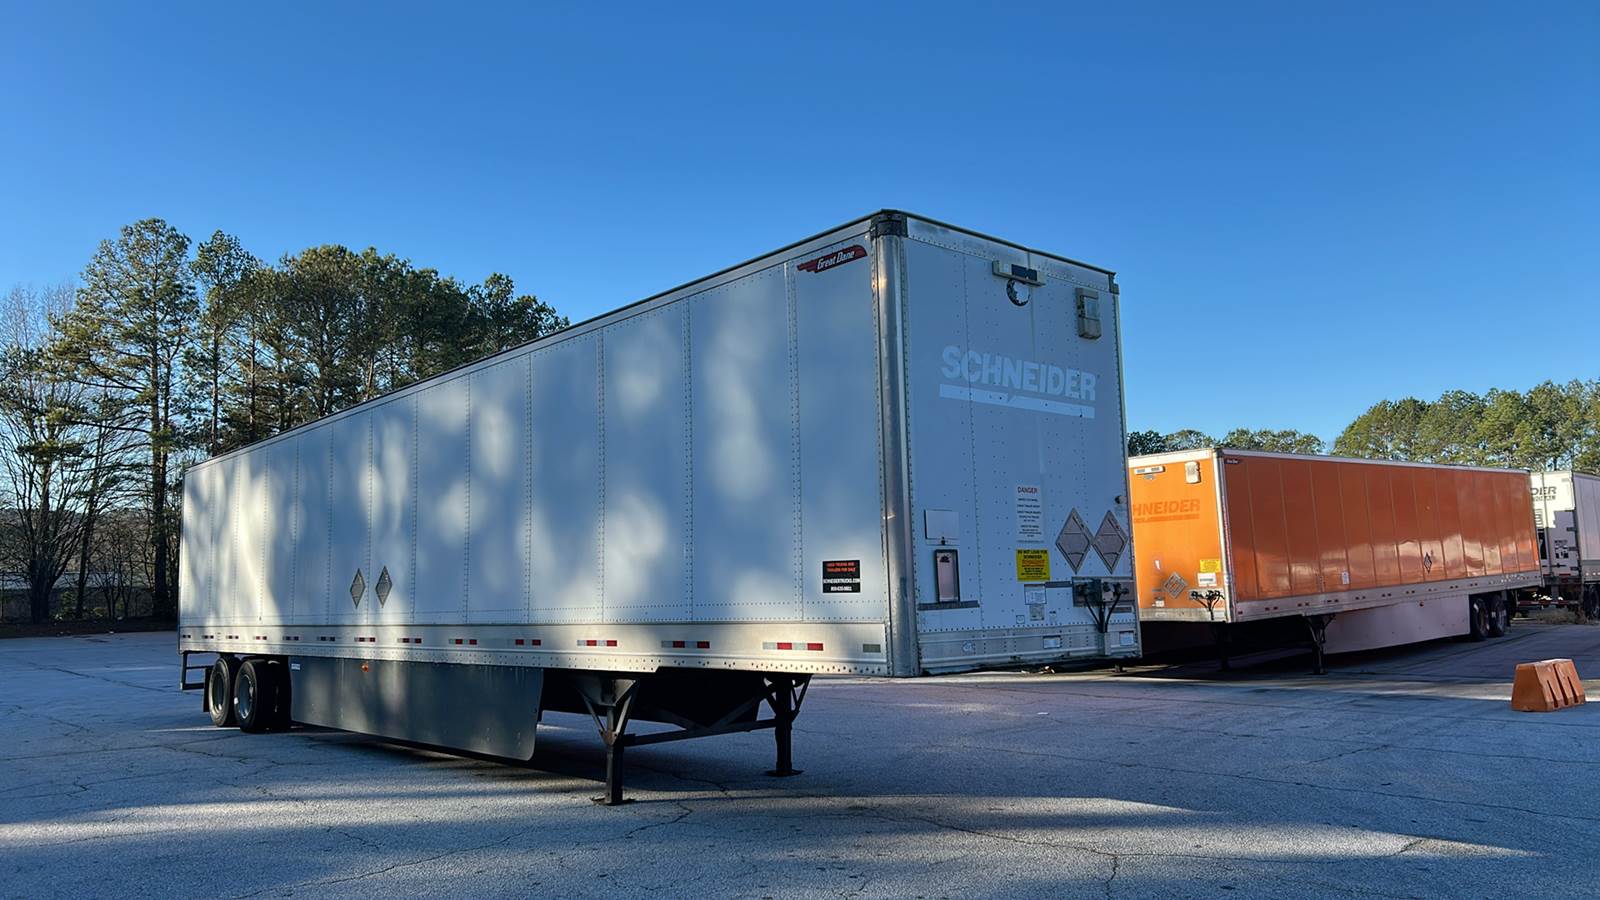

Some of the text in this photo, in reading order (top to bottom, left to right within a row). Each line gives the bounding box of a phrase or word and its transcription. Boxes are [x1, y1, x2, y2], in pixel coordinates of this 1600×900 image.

[817, 250, 855, 270] Great Dane
[941, 345, 1096, 401] SCHNEIDER
[1017, 486, 1038, 494] DANGER
